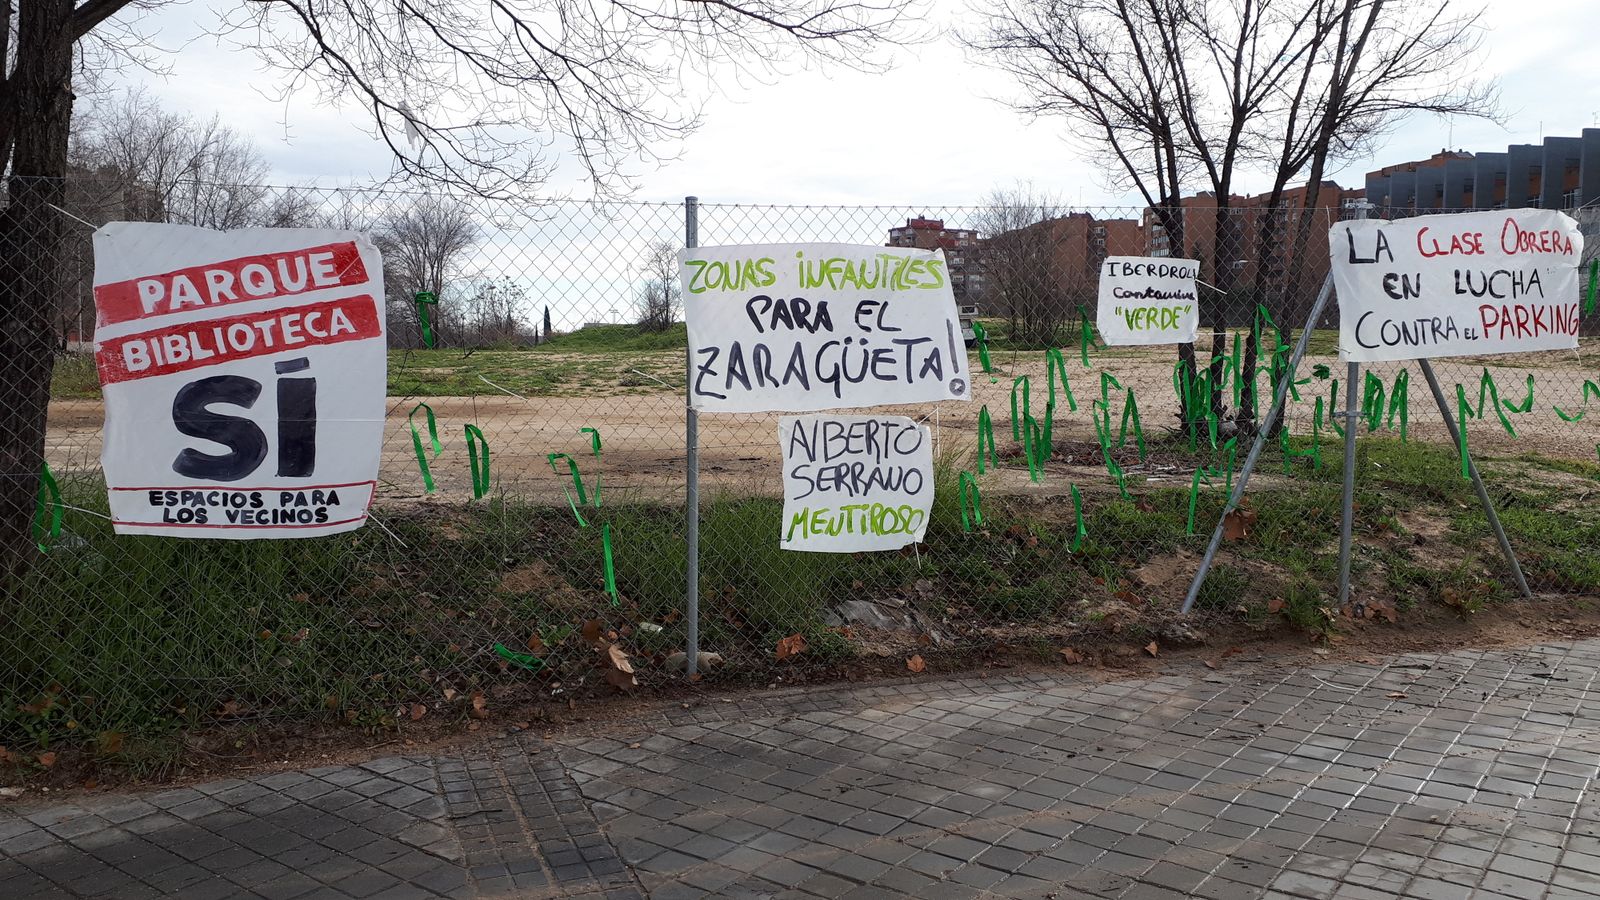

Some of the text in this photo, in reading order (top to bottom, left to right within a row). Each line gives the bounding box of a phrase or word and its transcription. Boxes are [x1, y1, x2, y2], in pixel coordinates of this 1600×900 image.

[1346, 217, 1574, 264] LA CLASE OBRERA
[137, 251, 340, 314] PARQUE
[685, 251, 944, 293] ZONAS INFANTILES
[1382, 268, 1545, 300] EN LUCHA
[745, 294, 902, 334] PARA EL
[1355, 303, 1580, 348] CONTRA EL PARKING
[122, 306, 357, 373] BIBLIOTECA
[694, 318, 966, 400] ZARAGÜETA!
[172, 357, 317, 482] SÍ
[149, 489, 340, 508] ESPACIOS PARA
[791, 461, 923, 500] SERRANO
[163, 506, 329, 525] LOS VECINOS
[787, 502, 925, 542] MENTIROSO
